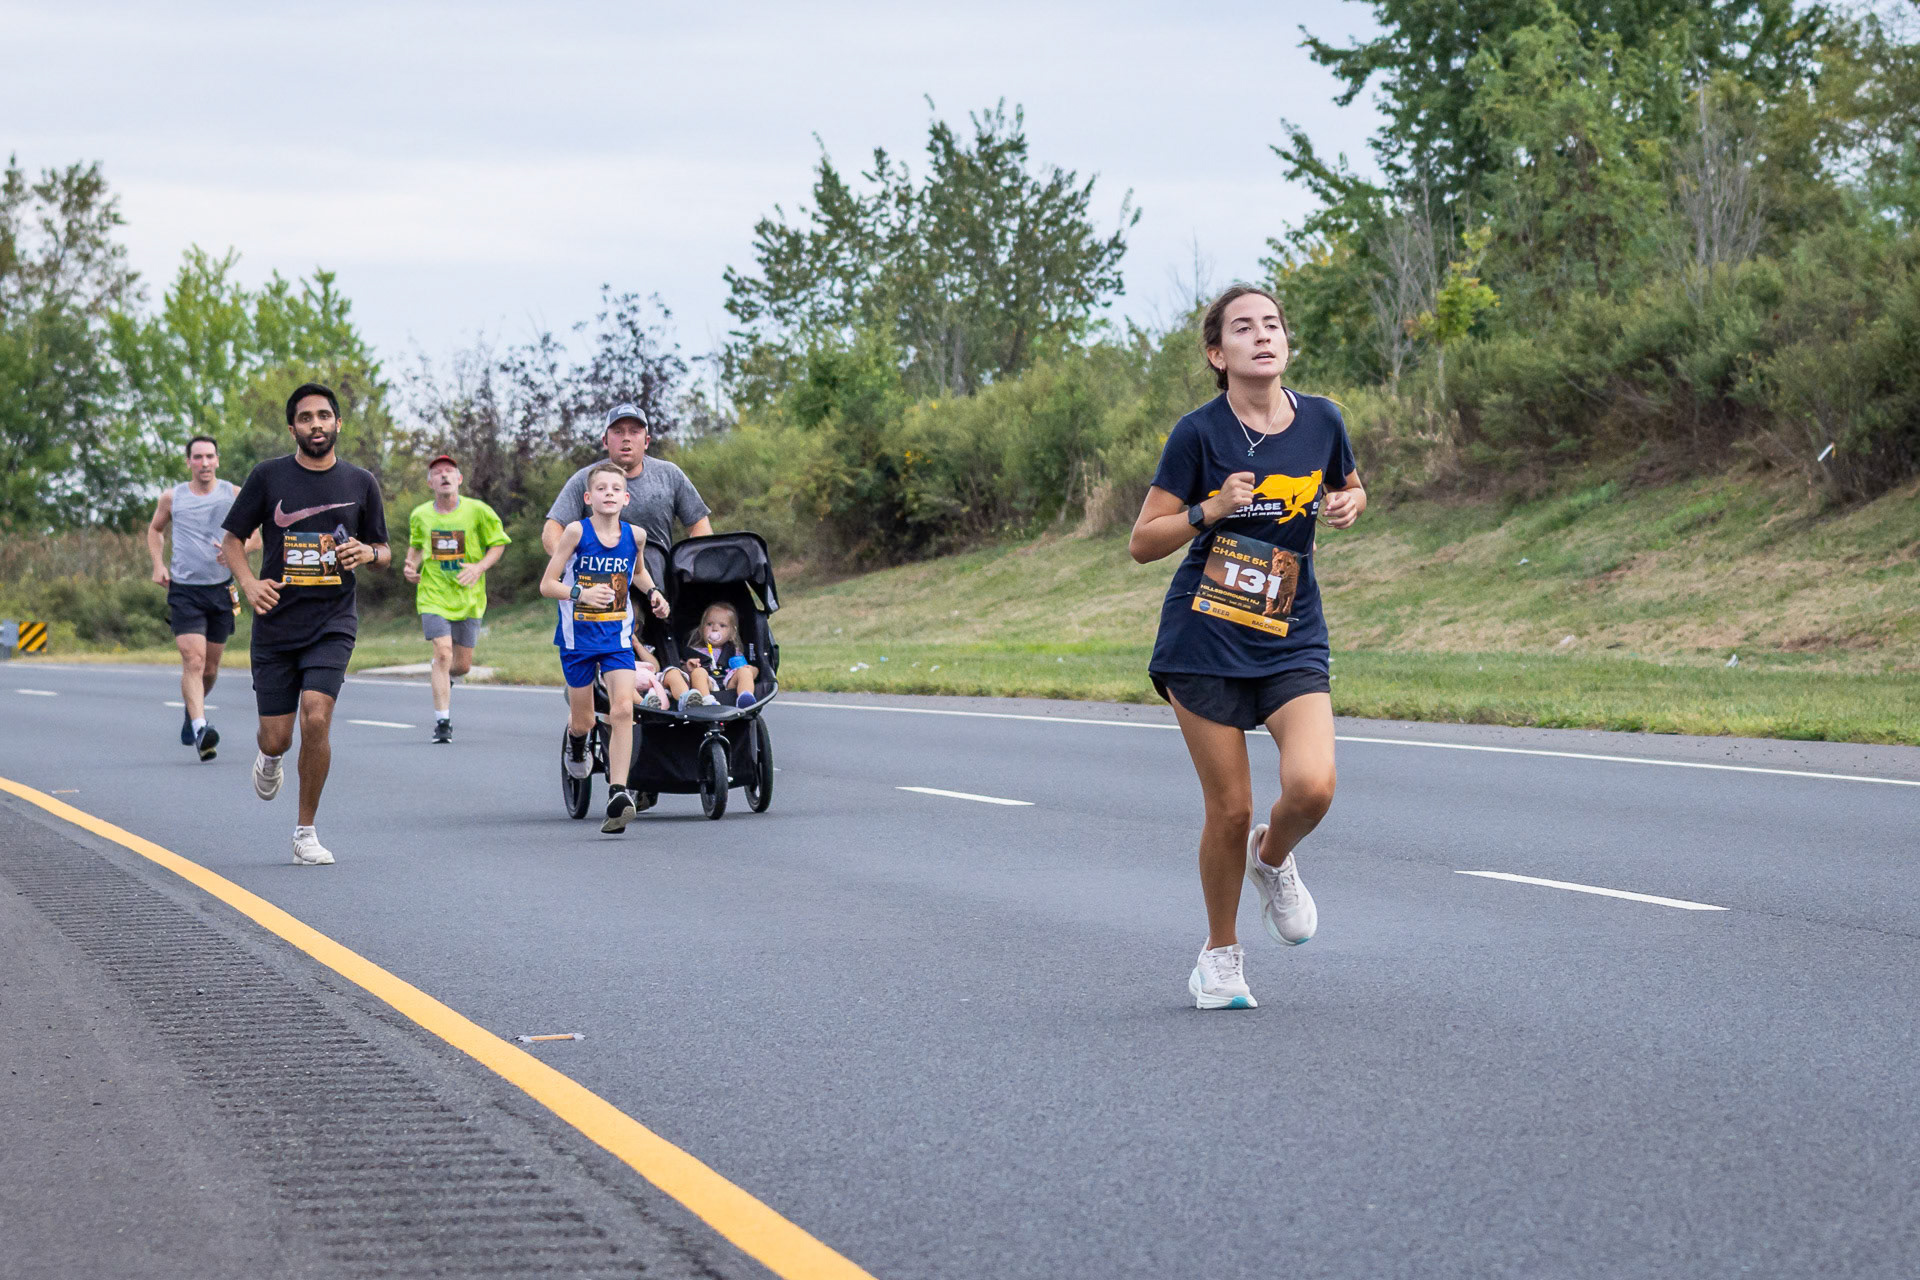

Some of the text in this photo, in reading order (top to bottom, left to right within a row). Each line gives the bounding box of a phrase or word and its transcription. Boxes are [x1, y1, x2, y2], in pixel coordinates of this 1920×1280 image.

[1216, 535, 1238, 548] THE
[286, 549, 337, 565] 224
[580, 556, 629, 572] FLYERS
[1212, 546, 1269, 568] CHASE 5K
[1224, 561, 1282, 600] 131
[1212, 607, 1230, 618] BEER
[1251, 619, 1263, 629] BAG
[1263, 622, 1282, 634] CHECK
